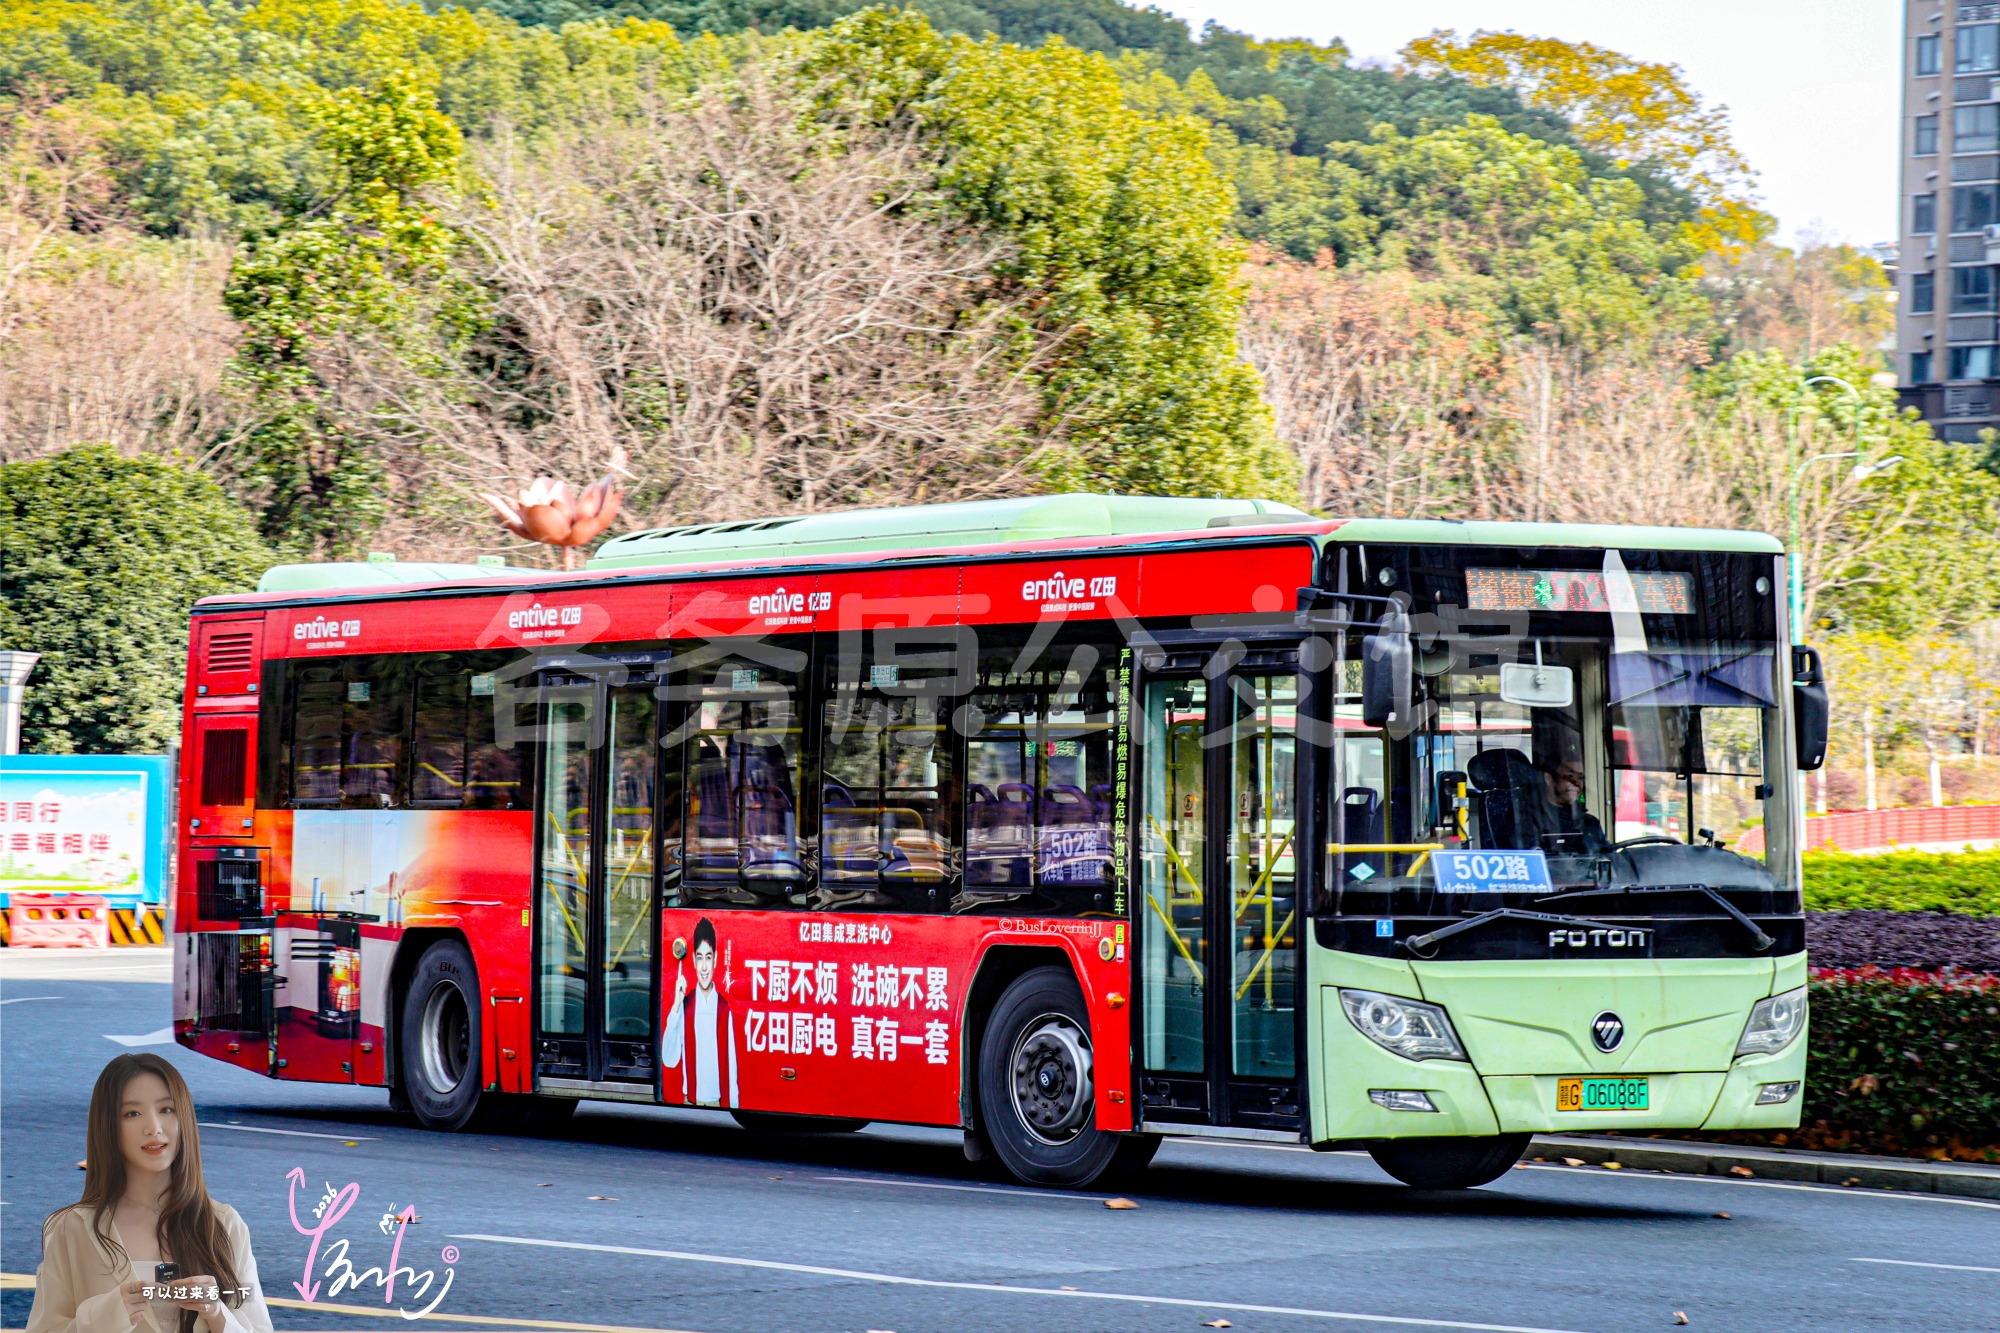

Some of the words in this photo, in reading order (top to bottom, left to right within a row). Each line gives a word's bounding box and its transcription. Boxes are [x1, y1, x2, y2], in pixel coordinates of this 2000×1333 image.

[1089, 576, 1117, 597] 亿田
[1114, 648, 1131, 915] 严禁携带易燃易爆危险物品上车
[0, 833, 110, 854] 幸福相伴
[1452, 855, 1530, 881] 502路
[799, 921, 892, 945] 亿田集成烹洗中心
[1549, 929, 1645, 947] FOTON
[744, 959, 838, 1005] 下厨不烦
[851, 962, 949, 1011] 洗碗不累
[744, 1009, 838, 1056] 亿田厨电
[851, 1015, 949, 1065] 真有一套
